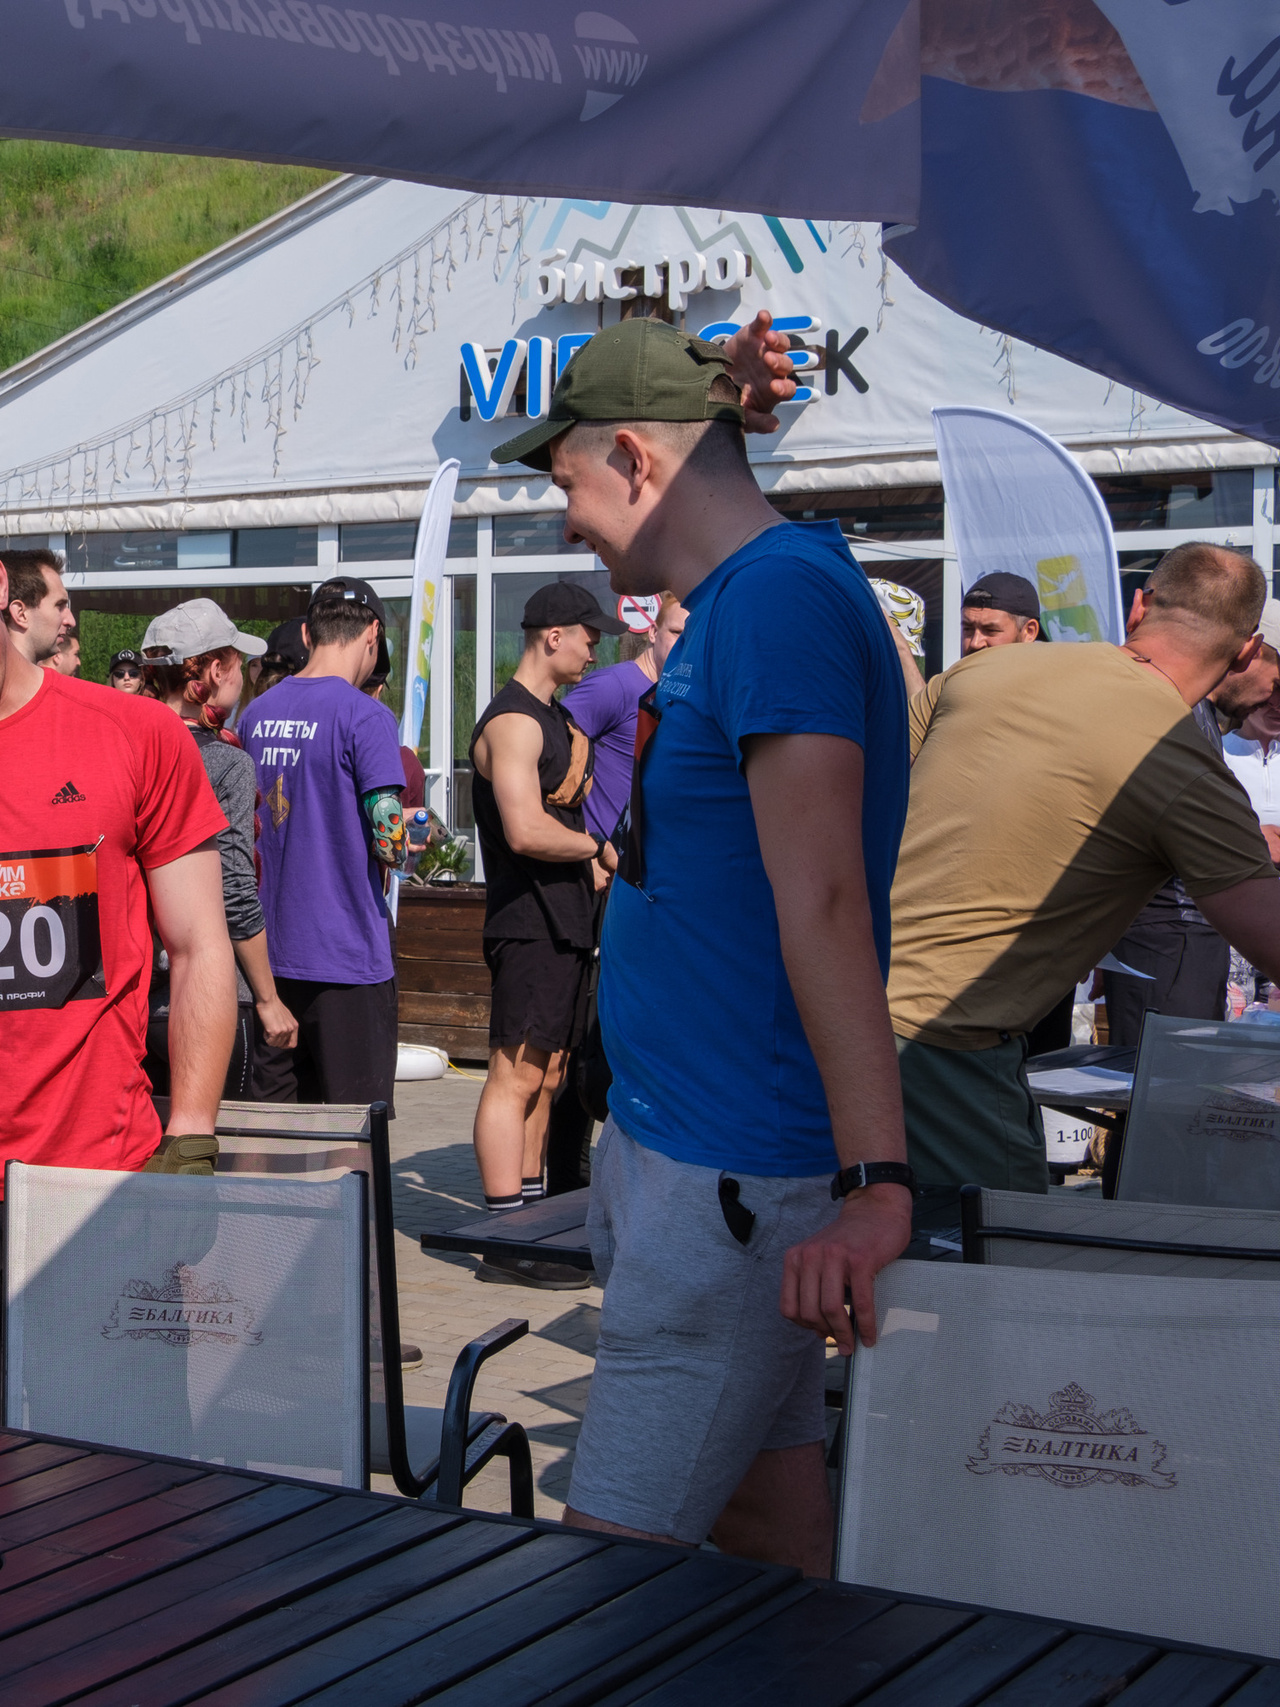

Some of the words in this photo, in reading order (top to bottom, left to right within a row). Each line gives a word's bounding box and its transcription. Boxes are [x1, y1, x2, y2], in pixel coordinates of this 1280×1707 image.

[532, 248, 746, 312] бистро
[251, 720, 318, 740] АТЛЕТЫ
[261, 747, 301, 767] ЛГТУ
[51, 794, 86, 805] adidas
[6, 991, 45, 1001] ПРОФИ
[1216, 1114, 1275, 1129] БАЛТИКА
[1057, 1127, 1093, 1143] 1-100
[146, 1308, 234, 1325] БАЛТИКА
[1024, 1438, 1139, 1462] БАЛТИКА
